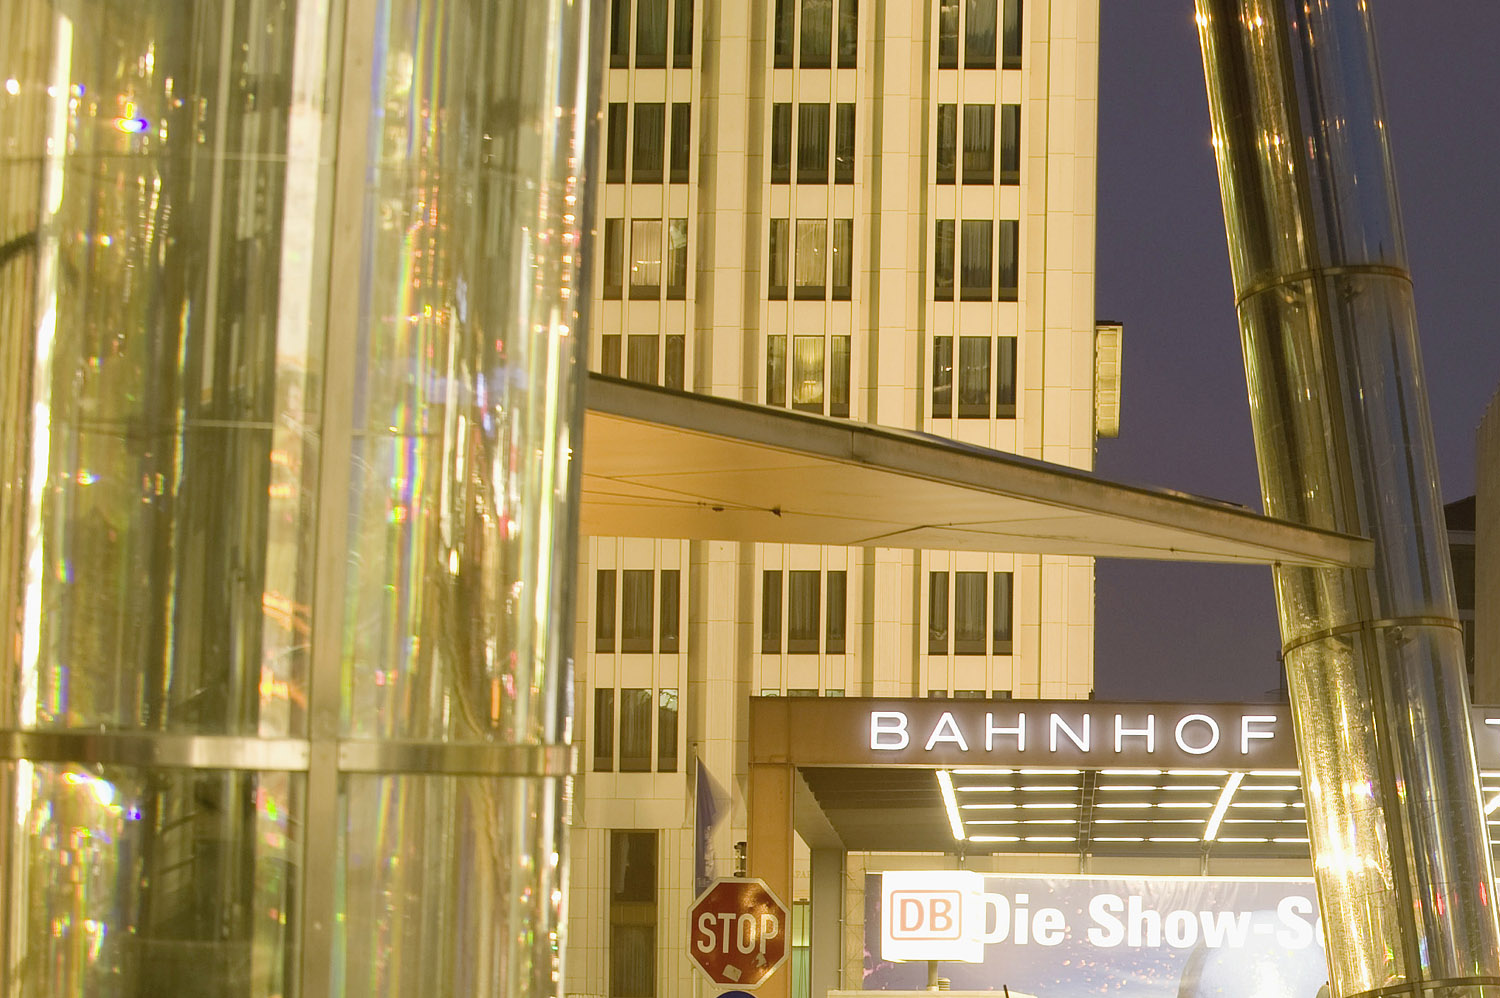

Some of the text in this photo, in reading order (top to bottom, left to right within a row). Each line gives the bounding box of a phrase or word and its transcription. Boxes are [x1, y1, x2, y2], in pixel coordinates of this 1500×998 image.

[870, 711, 1277, 755] BAHNHOF
[697, 911, 779, 955] STOP
[899, 898, 953, 932] DB
[983, 891, 1066, 946] Die
